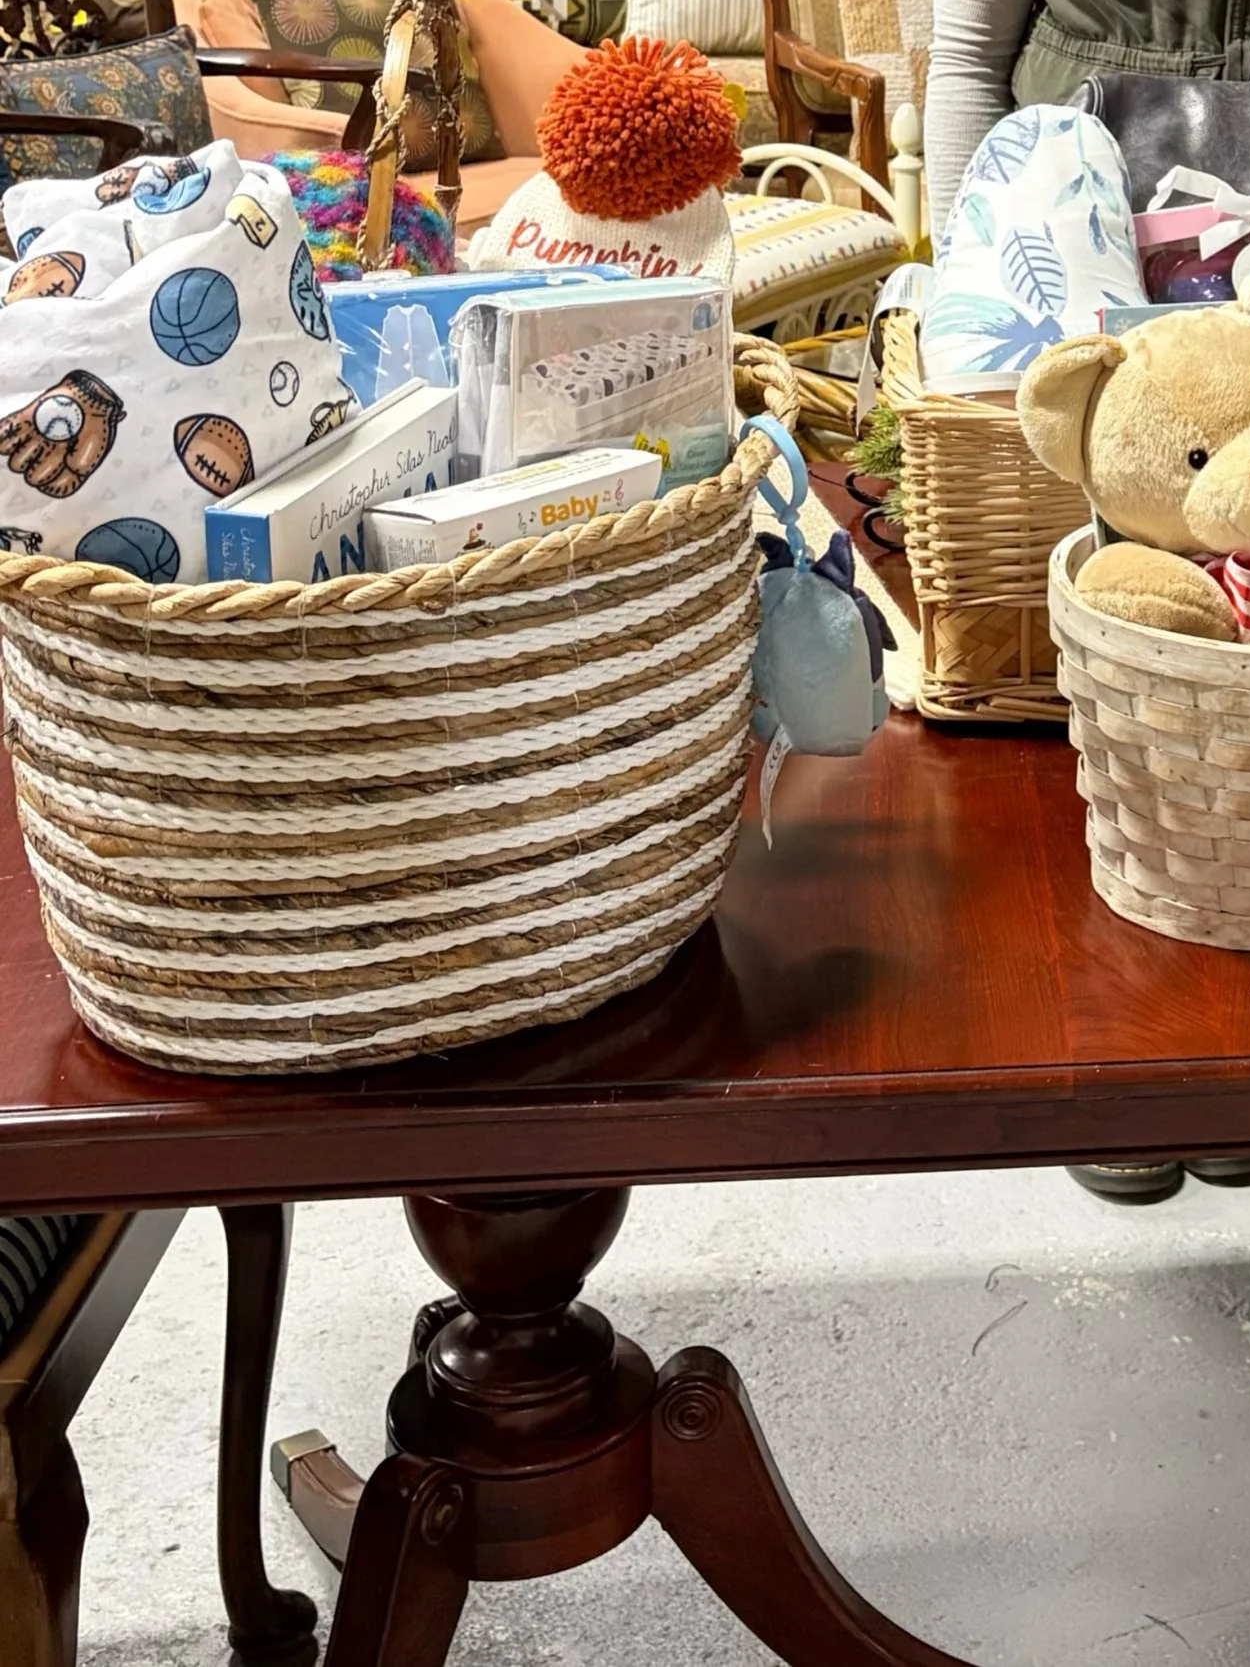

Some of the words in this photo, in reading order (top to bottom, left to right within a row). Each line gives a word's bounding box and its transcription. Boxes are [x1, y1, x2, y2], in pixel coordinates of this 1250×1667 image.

[309, 468, 391, 541] Christopher
[396, 450, 425, 479] Silas
[540, 493, 599, 527] Baby
